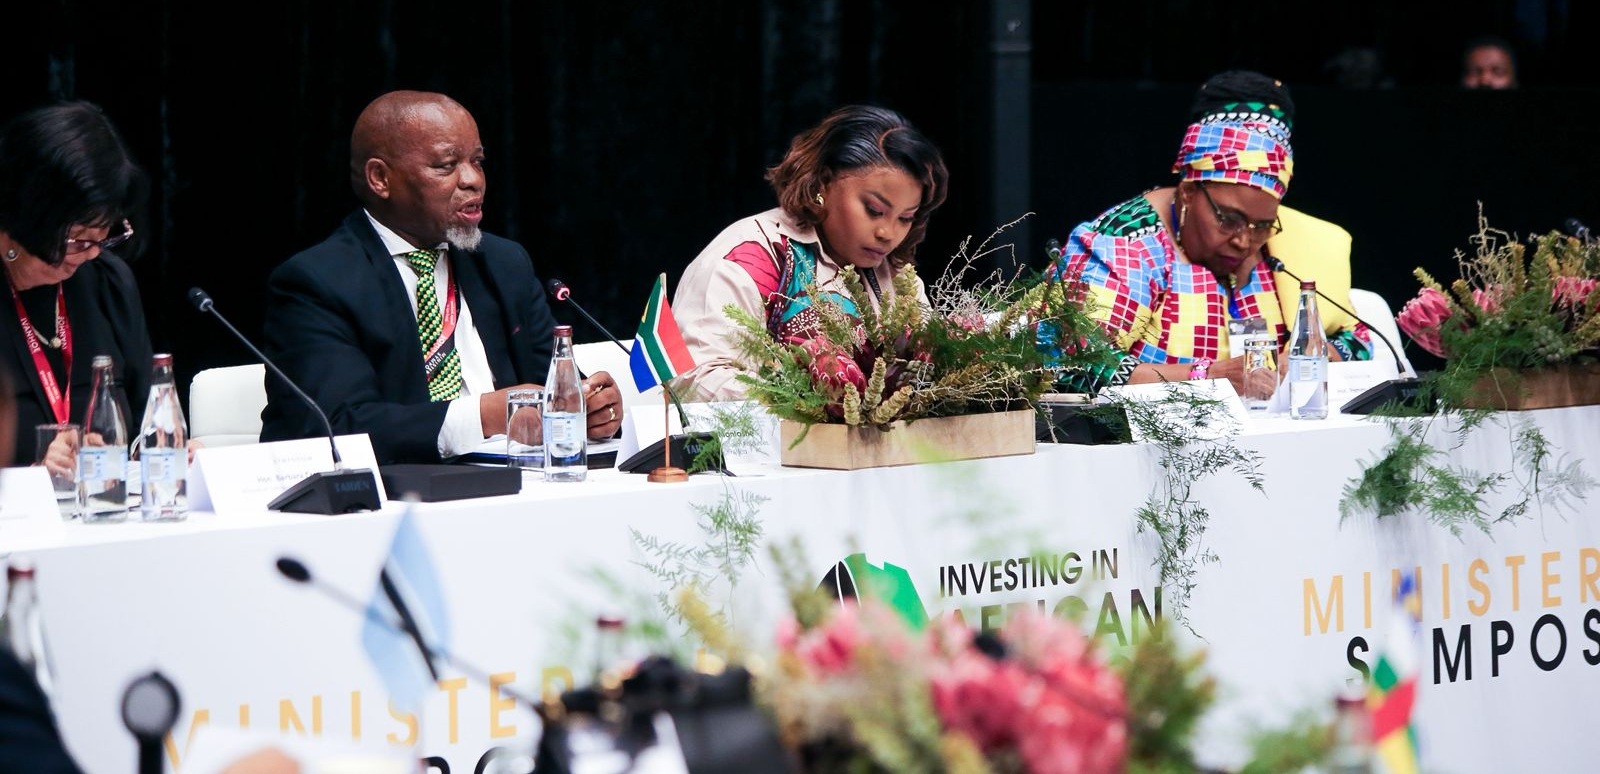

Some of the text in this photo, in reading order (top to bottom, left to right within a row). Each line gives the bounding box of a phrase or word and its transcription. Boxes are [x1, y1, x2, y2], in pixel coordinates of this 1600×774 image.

[940, 548, 1119, 598] INVESTING IN
[1303, 547, 1600, 636] MINISTER
[936, 586, 1163, 648] FCAN
[1346, 608, 1600, 687] SMPOS
